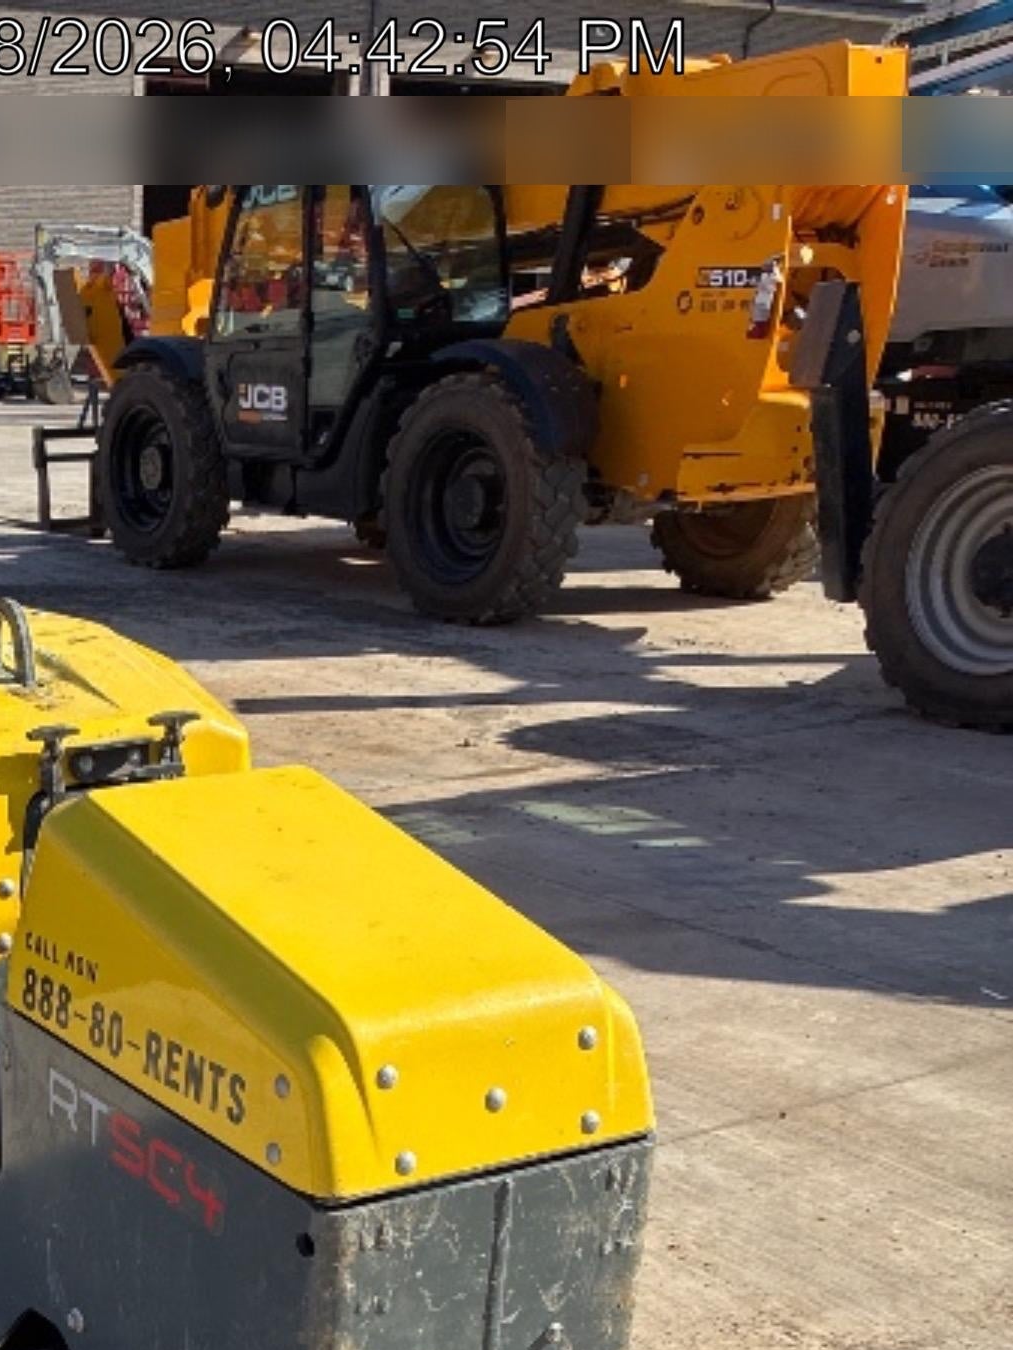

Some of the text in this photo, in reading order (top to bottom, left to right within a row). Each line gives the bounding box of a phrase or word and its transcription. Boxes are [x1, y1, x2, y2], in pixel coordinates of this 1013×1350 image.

[239, 383, 288, 411] JCB
[25, 931, 60, 964] CALL
[22, 967, 247, 1125] 888-80-RENTS
